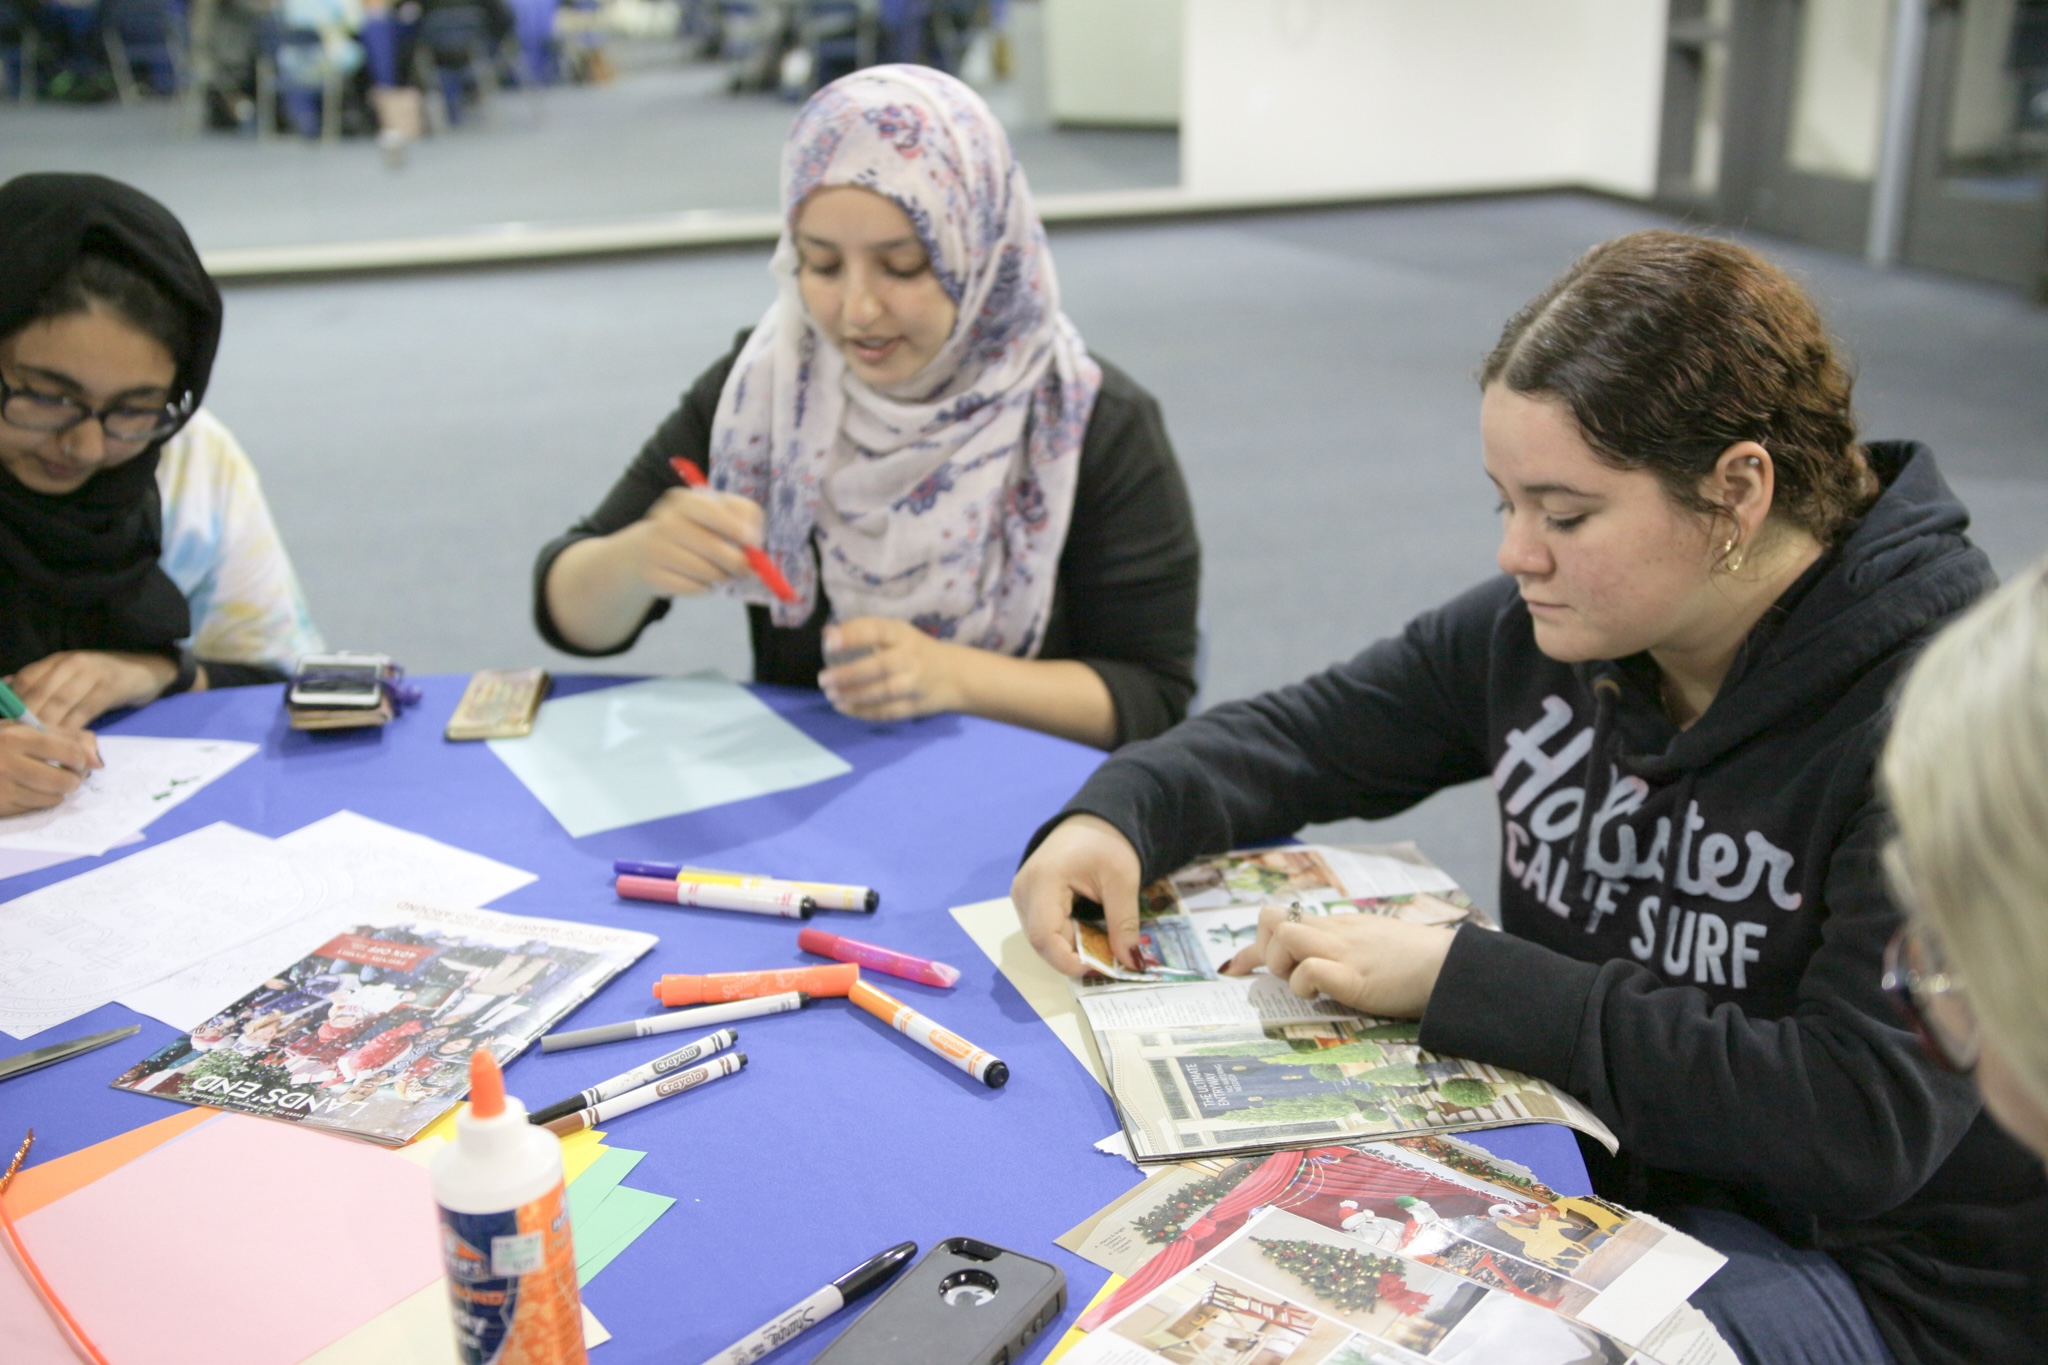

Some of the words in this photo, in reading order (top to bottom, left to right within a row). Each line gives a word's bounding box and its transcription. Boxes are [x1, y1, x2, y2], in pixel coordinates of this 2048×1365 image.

[1492, 694, 1802, 912] Holister
[1630, 896, 1767, 989] SURF
[933, 1029, 968, 1055] Crayola
[655, 1048, 697, 1072] Crayola
[660, 1071, 704, 1095] Crayola
[1185, 1063, 1209, 1093] ULTIMATE
[1203, 1072, 1230, 1106] ENTRYWAY
[1200, 1093, 1216, 1108] THE
